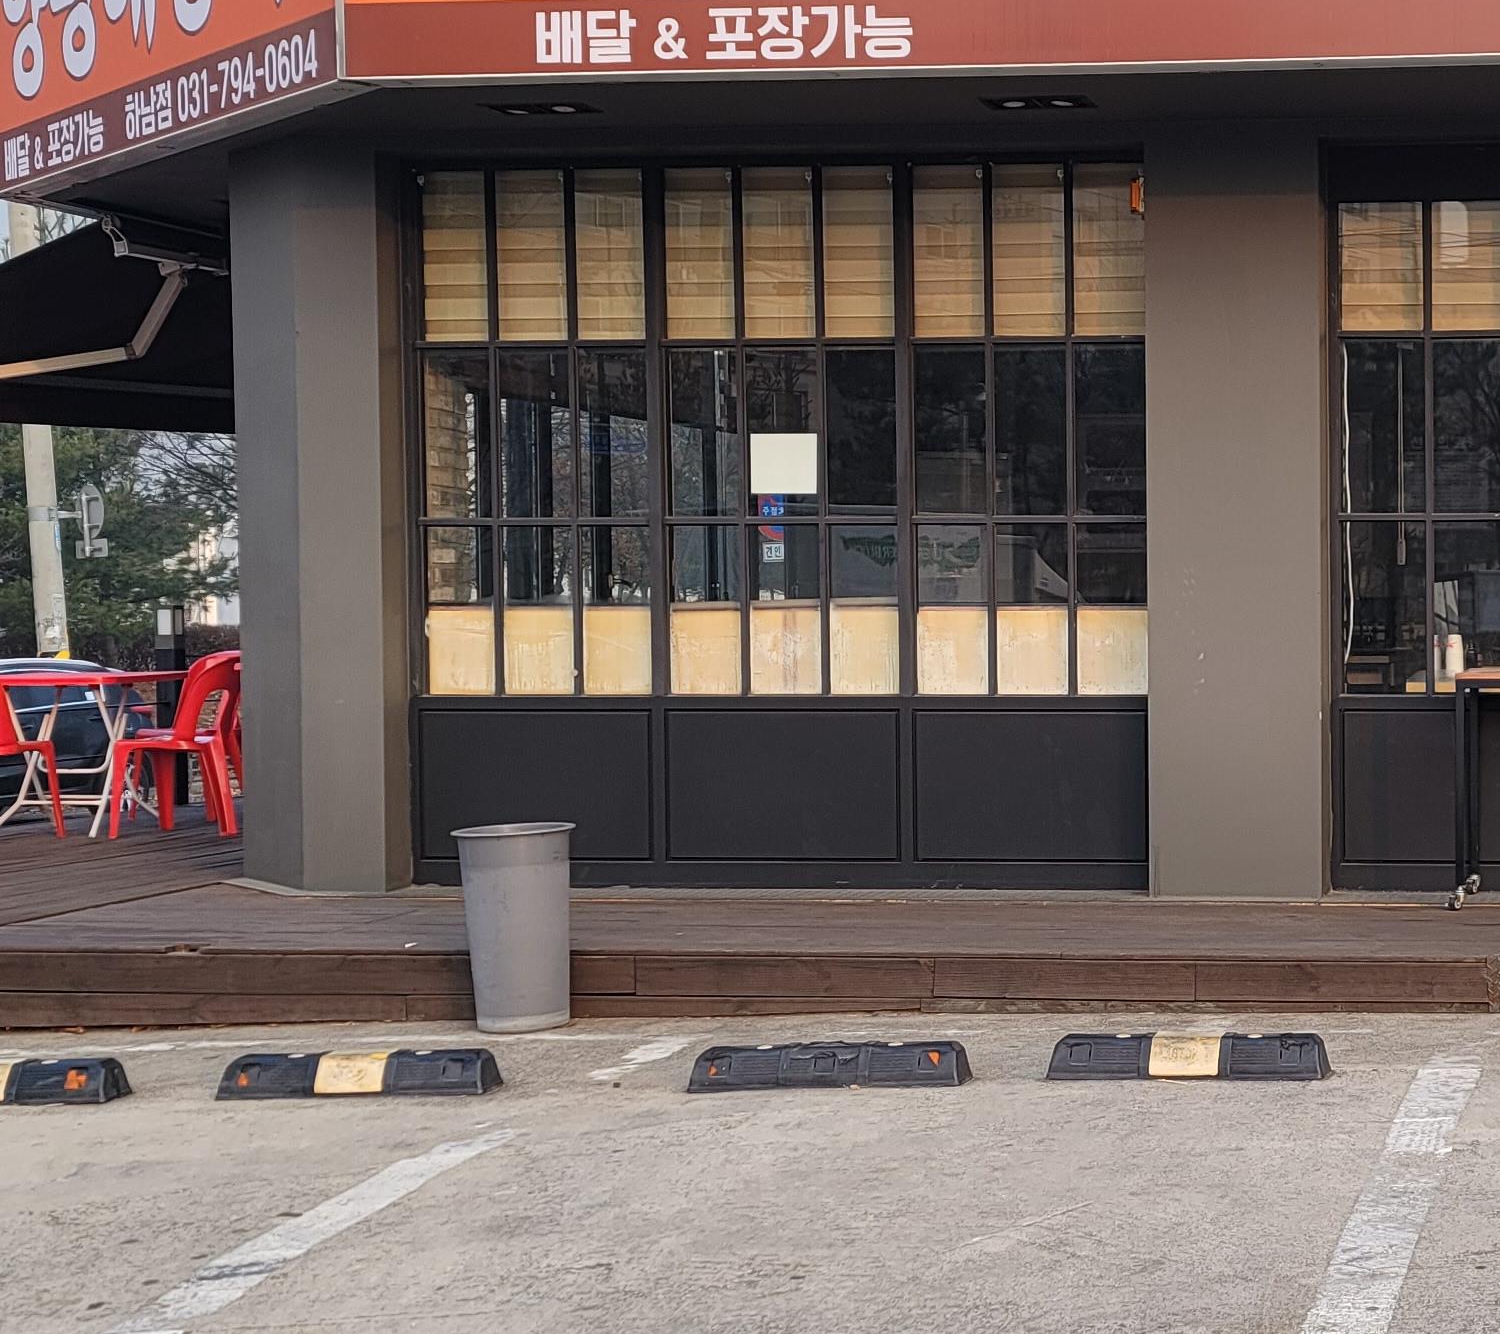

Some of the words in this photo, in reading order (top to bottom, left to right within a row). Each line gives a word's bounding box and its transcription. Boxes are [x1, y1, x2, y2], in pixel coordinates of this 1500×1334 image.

[534, 9, 636, 65] 배달
[653, 17, 688, 60] &
[705, 3, 914, 61] 포장가능
[3, 133, 31, 181] 배달
[34, 136, 44, 170] &
[47, 109, 104, 168] 포장가능
[124, 80, 173, 140] 하남점
[177, 29, 318, 124] 031-794-0604
